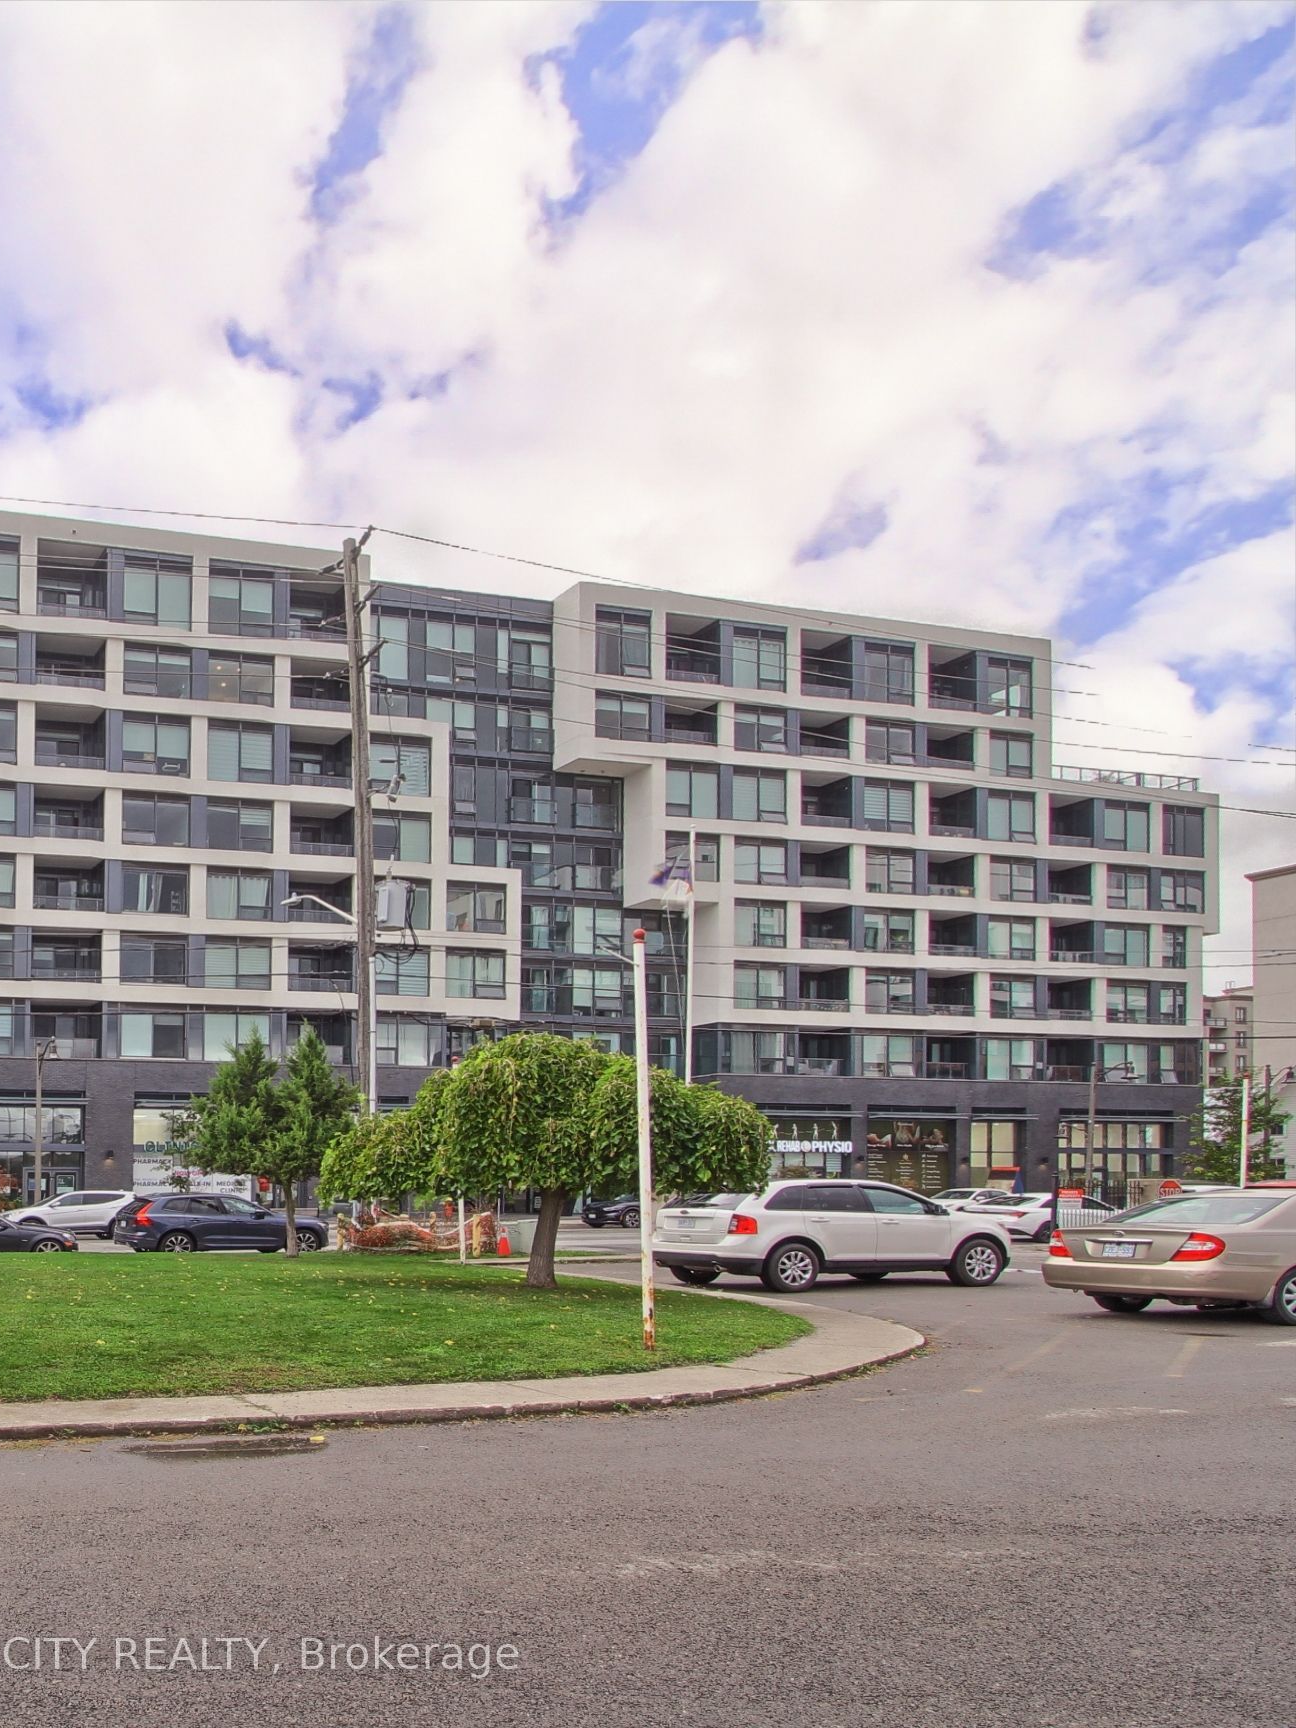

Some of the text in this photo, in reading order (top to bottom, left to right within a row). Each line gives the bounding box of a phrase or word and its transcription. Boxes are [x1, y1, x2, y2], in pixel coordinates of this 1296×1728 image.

[776, 1140, 801, 1153] REHAB
[811, 1140, 853, 1153] PHYSIO
[1160, 1187, 1181, 1197] STOP
